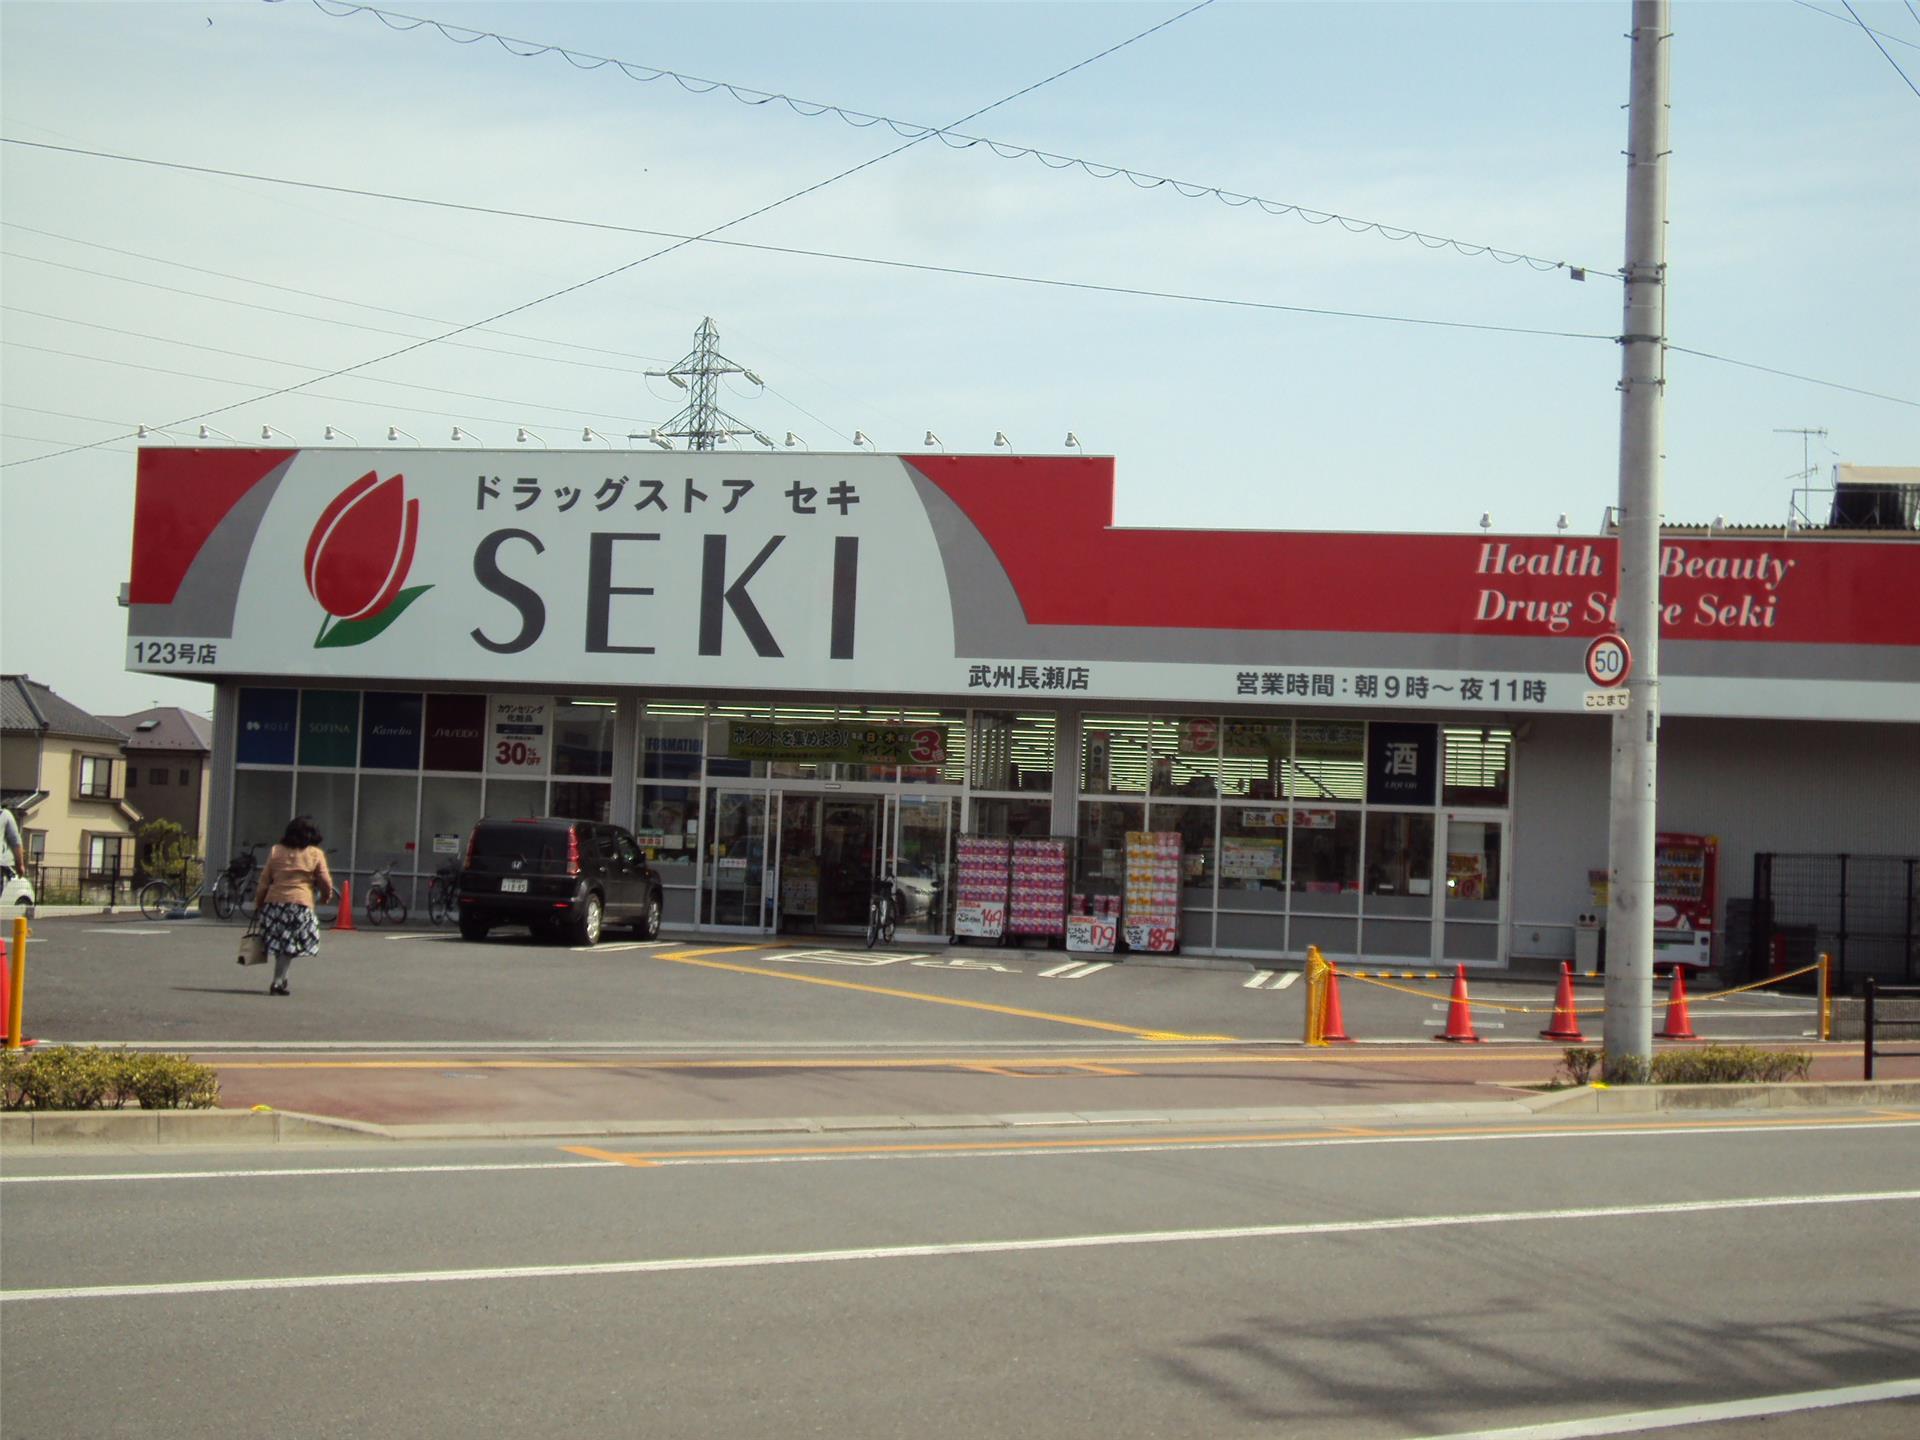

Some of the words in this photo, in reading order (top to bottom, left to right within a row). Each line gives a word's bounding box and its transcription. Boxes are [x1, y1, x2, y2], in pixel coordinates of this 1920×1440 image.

[476, 475, 755, 514] ドラッグストア
[784, 480, 860, 515] セキ
[1475, 543, 1602, 577] Health
[1658, 546, 1795, 590] Beauty
[470, 528, 859, 660] SEKI
[1474, 589, 1573, 632] Drug
[1583, 591, 1682, 625] Ste
[1694, 593, 1777, 628] Seki
[134, 641, 217, 665] 123号店
[1595, 650, 1619, 673] 50
[968, 665, 1090, 691] 武州長瀬店
[1585, 693, 1627, 708] ここまで
[1384, 742, 1419, 775] 酒
[981, 909, 1002, 928] 149
